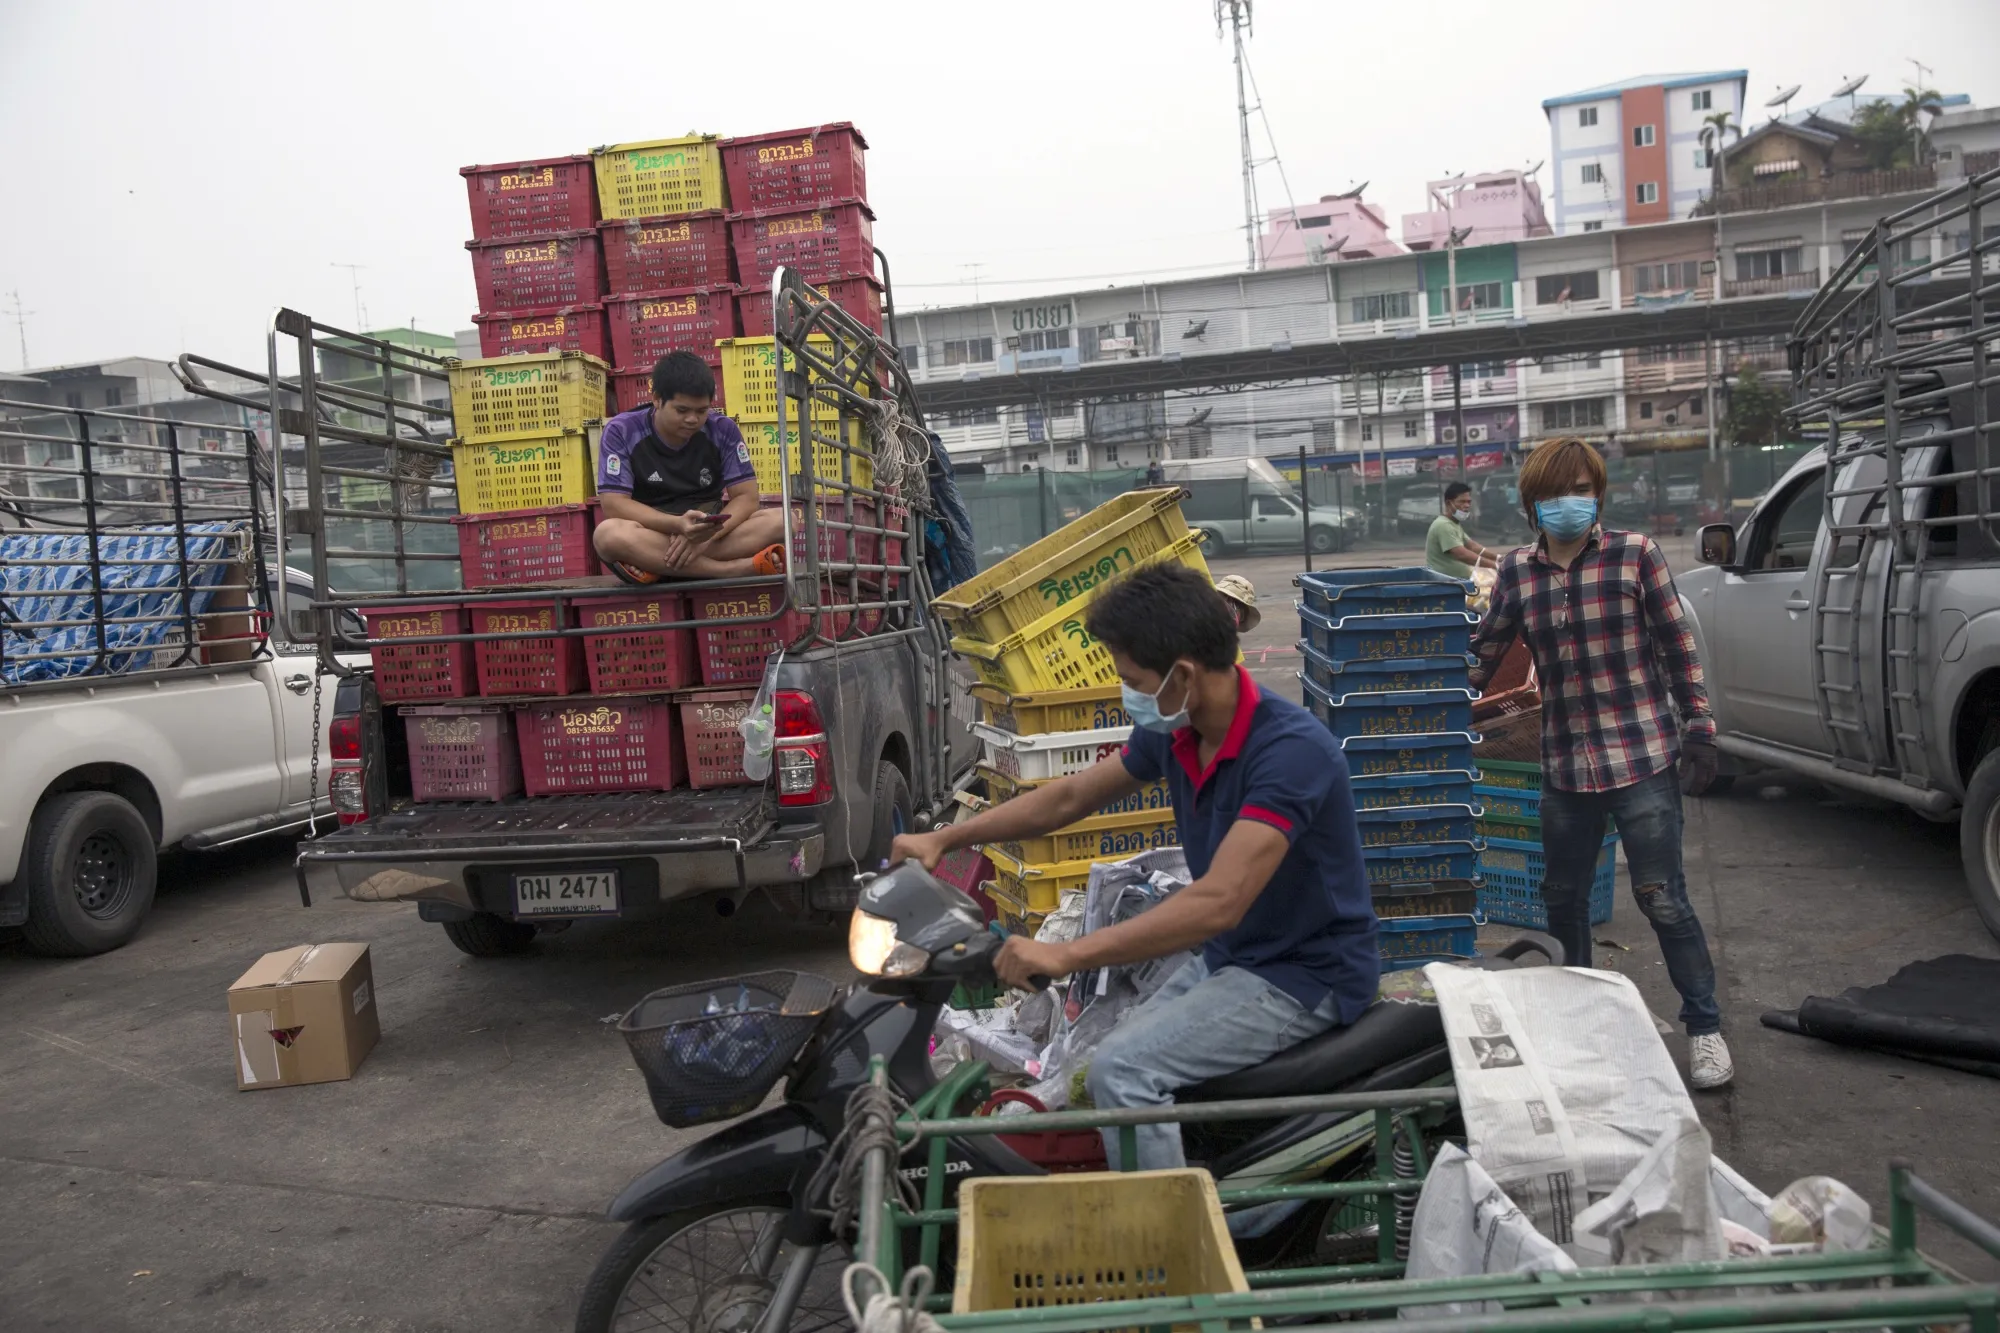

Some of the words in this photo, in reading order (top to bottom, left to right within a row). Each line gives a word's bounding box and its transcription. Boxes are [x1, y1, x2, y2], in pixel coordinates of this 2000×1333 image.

[628, 152, 686, 171] วิยะดา
[1012, 304, 1073, 331] ขายยา
[484, 367, 542, 387] วิยะดา
[488, 445, 546, 465] วิยะดา
[559, 706, 622, 727] น้องดิว
[566, 725, 616, 735] 081-3385635
[559, 876, 610, 899] 2471
[900, 1160, 974, 1179] HODA
